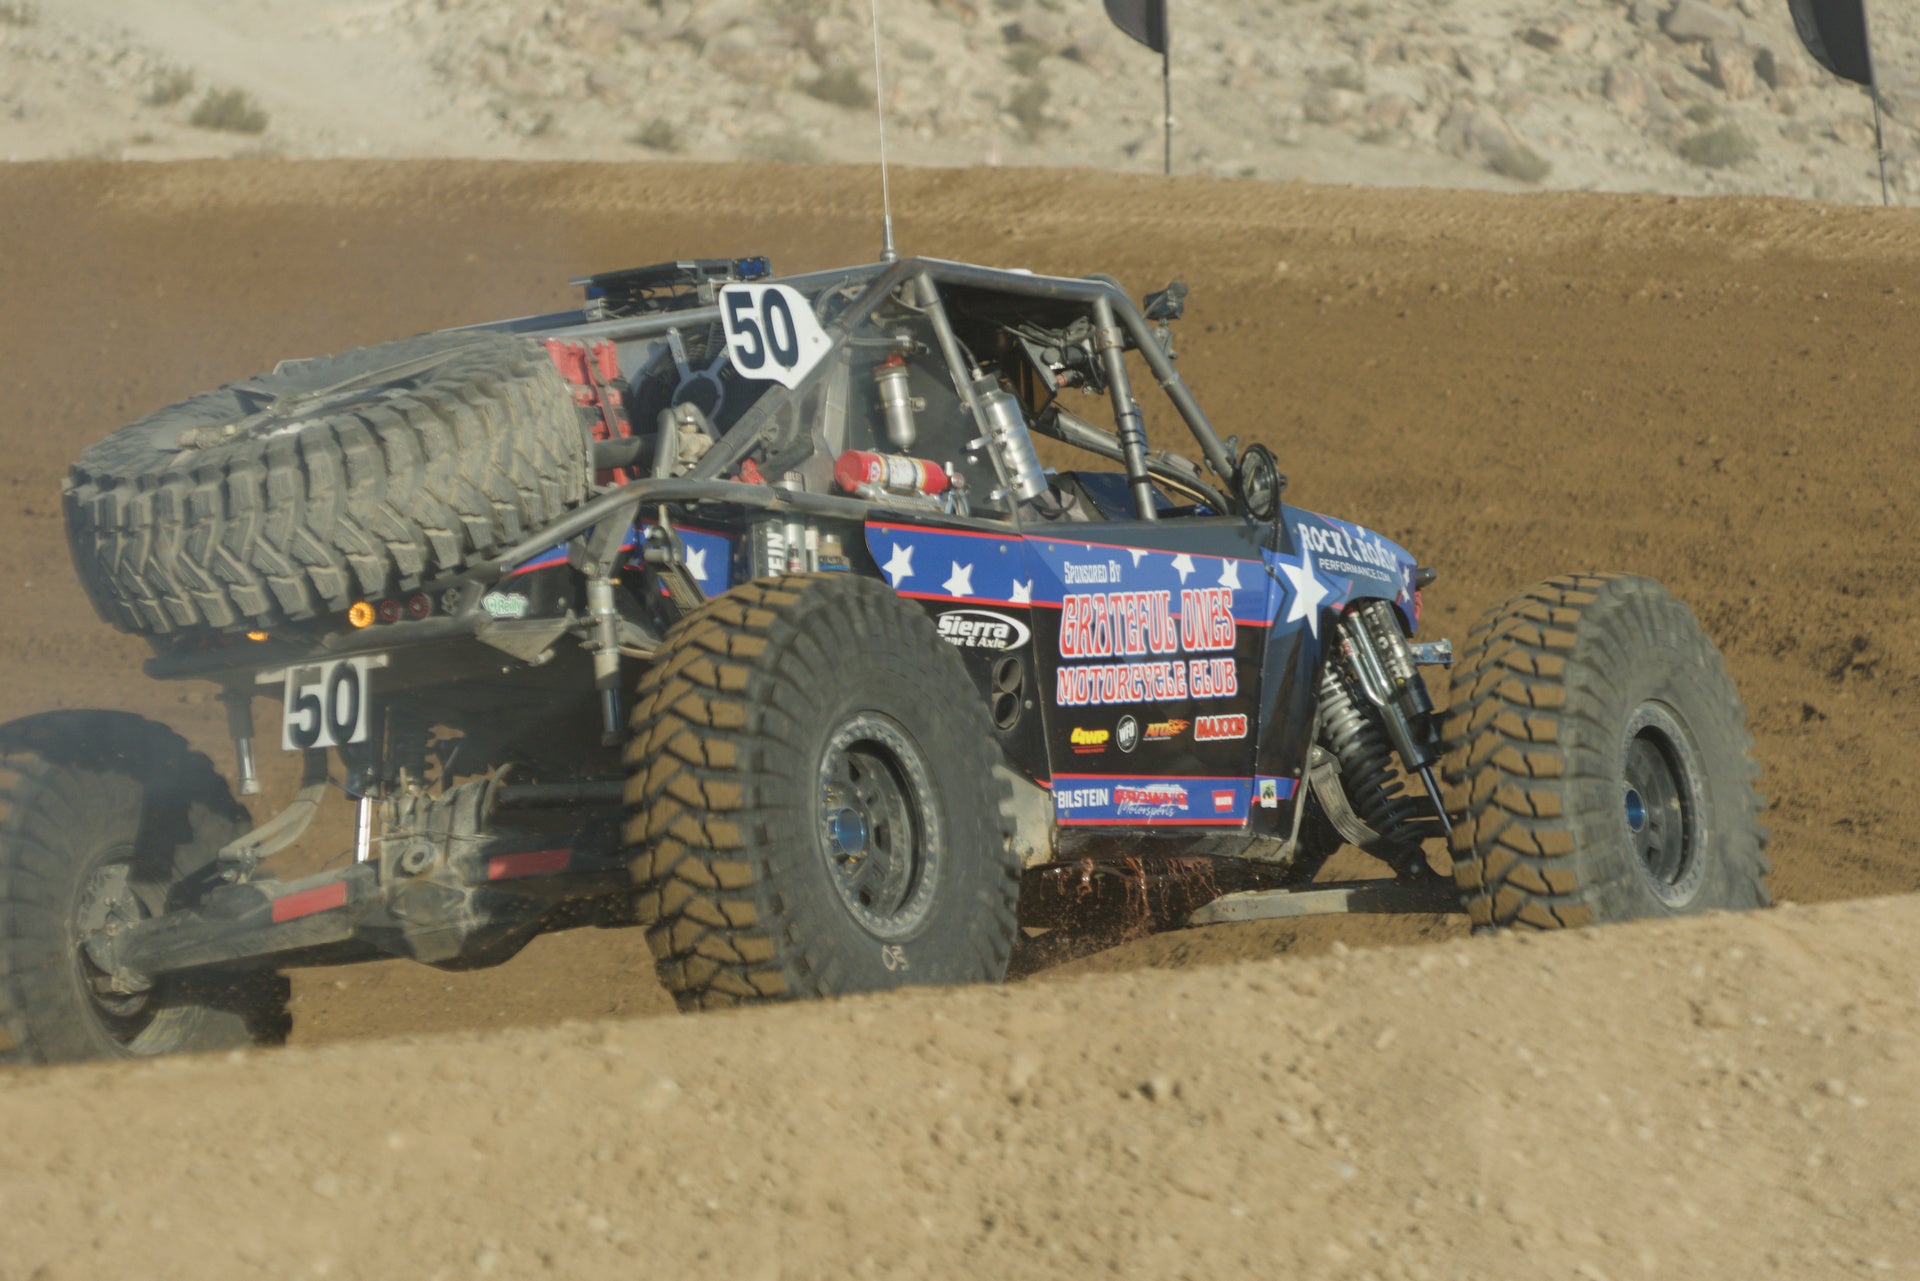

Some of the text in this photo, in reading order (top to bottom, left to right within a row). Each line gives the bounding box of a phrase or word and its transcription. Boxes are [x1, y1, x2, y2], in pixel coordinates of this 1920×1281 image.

[725, 288, 799, 371] 50
[1297, 523, 1349, 558] ROCK
[936, 615, 1010, 639] Sierra
[1059, 587, 1236, 659] GRATEFUL ONES
[965, 635, 975, 647] &
[977, 637, 1007, 648] Axle
[1056, 658, 1238, 705] MOTORCYCLE CLUB
[287, 661, 360, 748] 50
[1196, 715, 1246, 740] MAXXIS
[1057, 788, 1110, 808] BILSTEIN
[1113, 789, 1187, 806] BROWN'S
